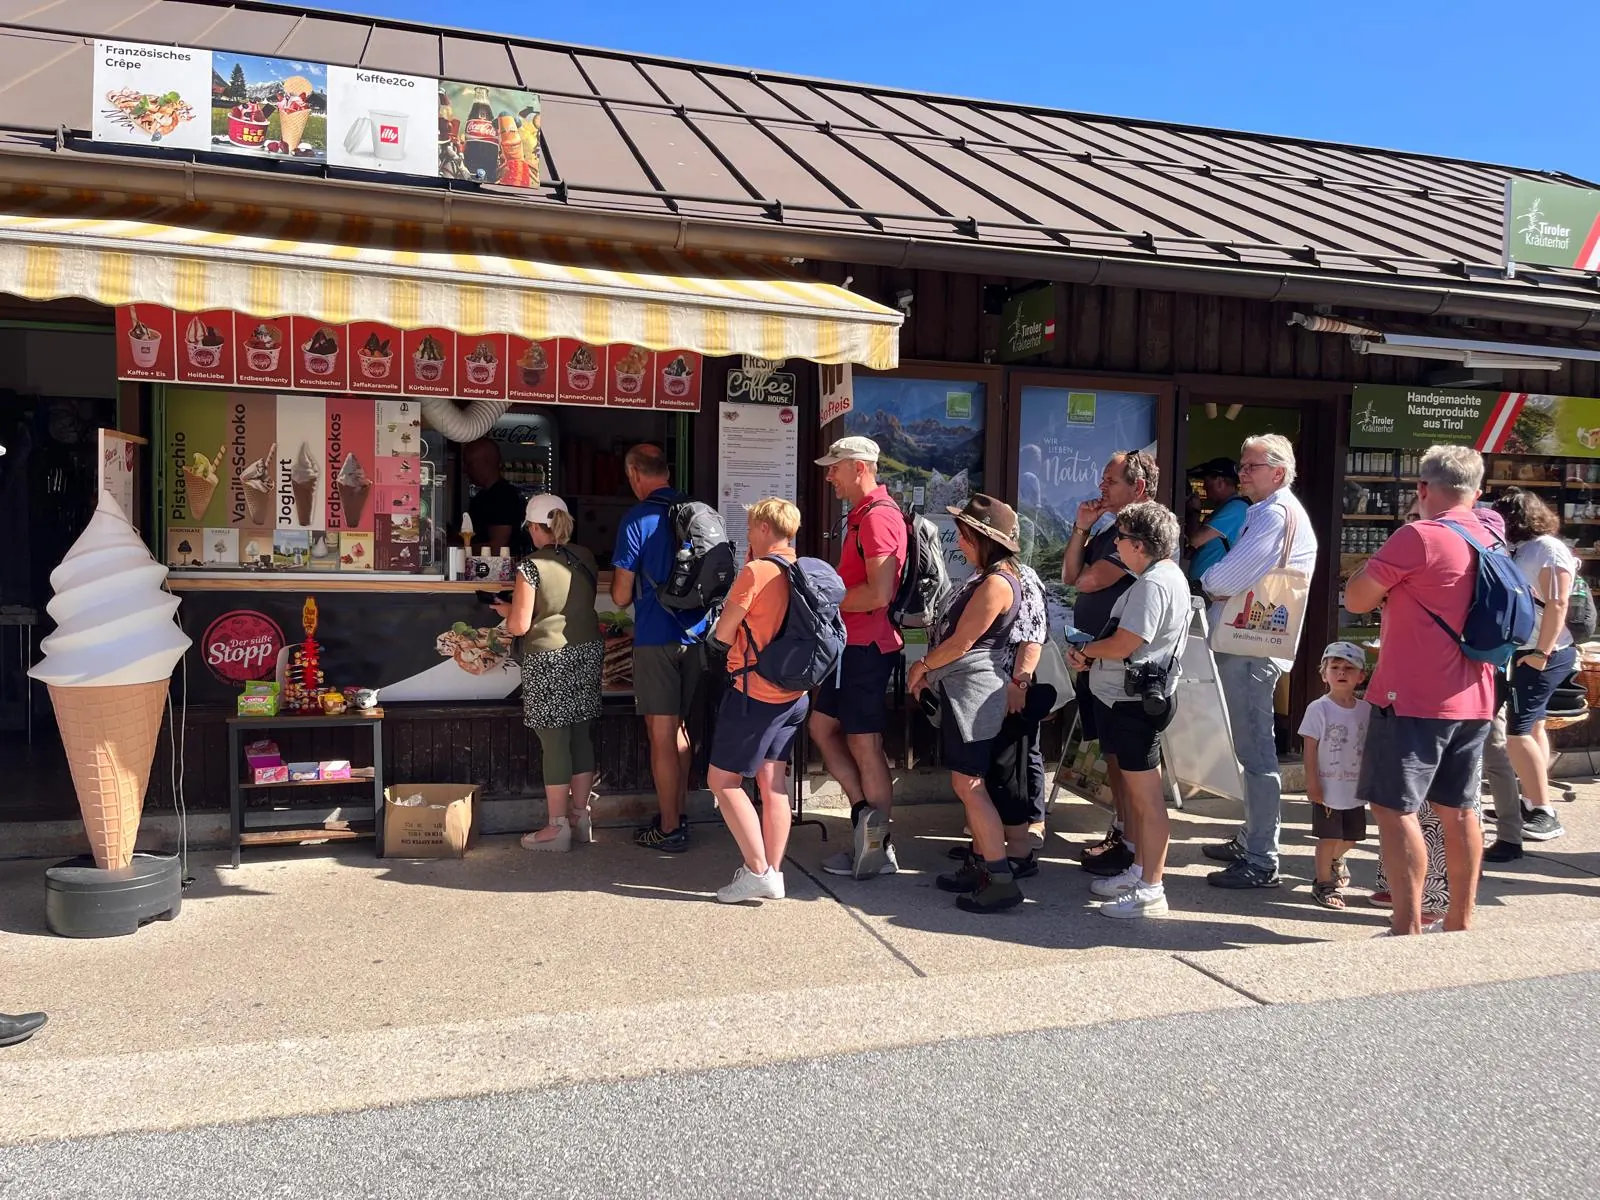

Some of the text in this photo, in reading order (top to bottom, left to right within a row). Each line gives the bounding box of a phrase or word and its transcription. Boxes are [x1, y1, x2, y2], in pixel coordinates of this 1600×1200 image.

[105, 44, 192, 62] Französisches
[105, 58, 142, 71] Crêpe
[356, 72, 415, 88] Kaffee2Go
[381, 128, 397, 142] illy
[1539, 222, 1570, 237] Tiroler
[1525, 233, 1569, 249] Kräuterhof
[127, 369, 149, 377] Kaffee
[239, 375, 289, 384] ErdbeerBounty
[300, 379, 341, 387] Kirschbecher
[352, 382, 398, 390] JaffaKaramelle
[408, 384, 449, 393] Kürbistraum
[728, 371, 793, 401] Coffee
[463, 387, 499, 397] Kinder Pop
[1407, 391, 1481, 405] Handgemachte
[767, 394, 789, 404] HOUSE
[1408, 404, 1479, 418] Naturprodukte
[1371, 415, 1394, 425] Tiroler
[1423, 419, 1464, 430] aus Tirol
[1043, 437, 1058, 445] WIR
[1048, 446, 1073, 454] LIEBEN
[232, 403, 246, 523] VanilleSchoko
[171, 431, 186, 520] Pistacchio
[328, 413, 342, 528] ErdbeerKokos
[279, 458, 295, 525] Joghurt
[230, 635, 273, 648] Der süße
[1232, 632, 1263, 643] Weilheim
[207, 642, 273, 668] Stopp
